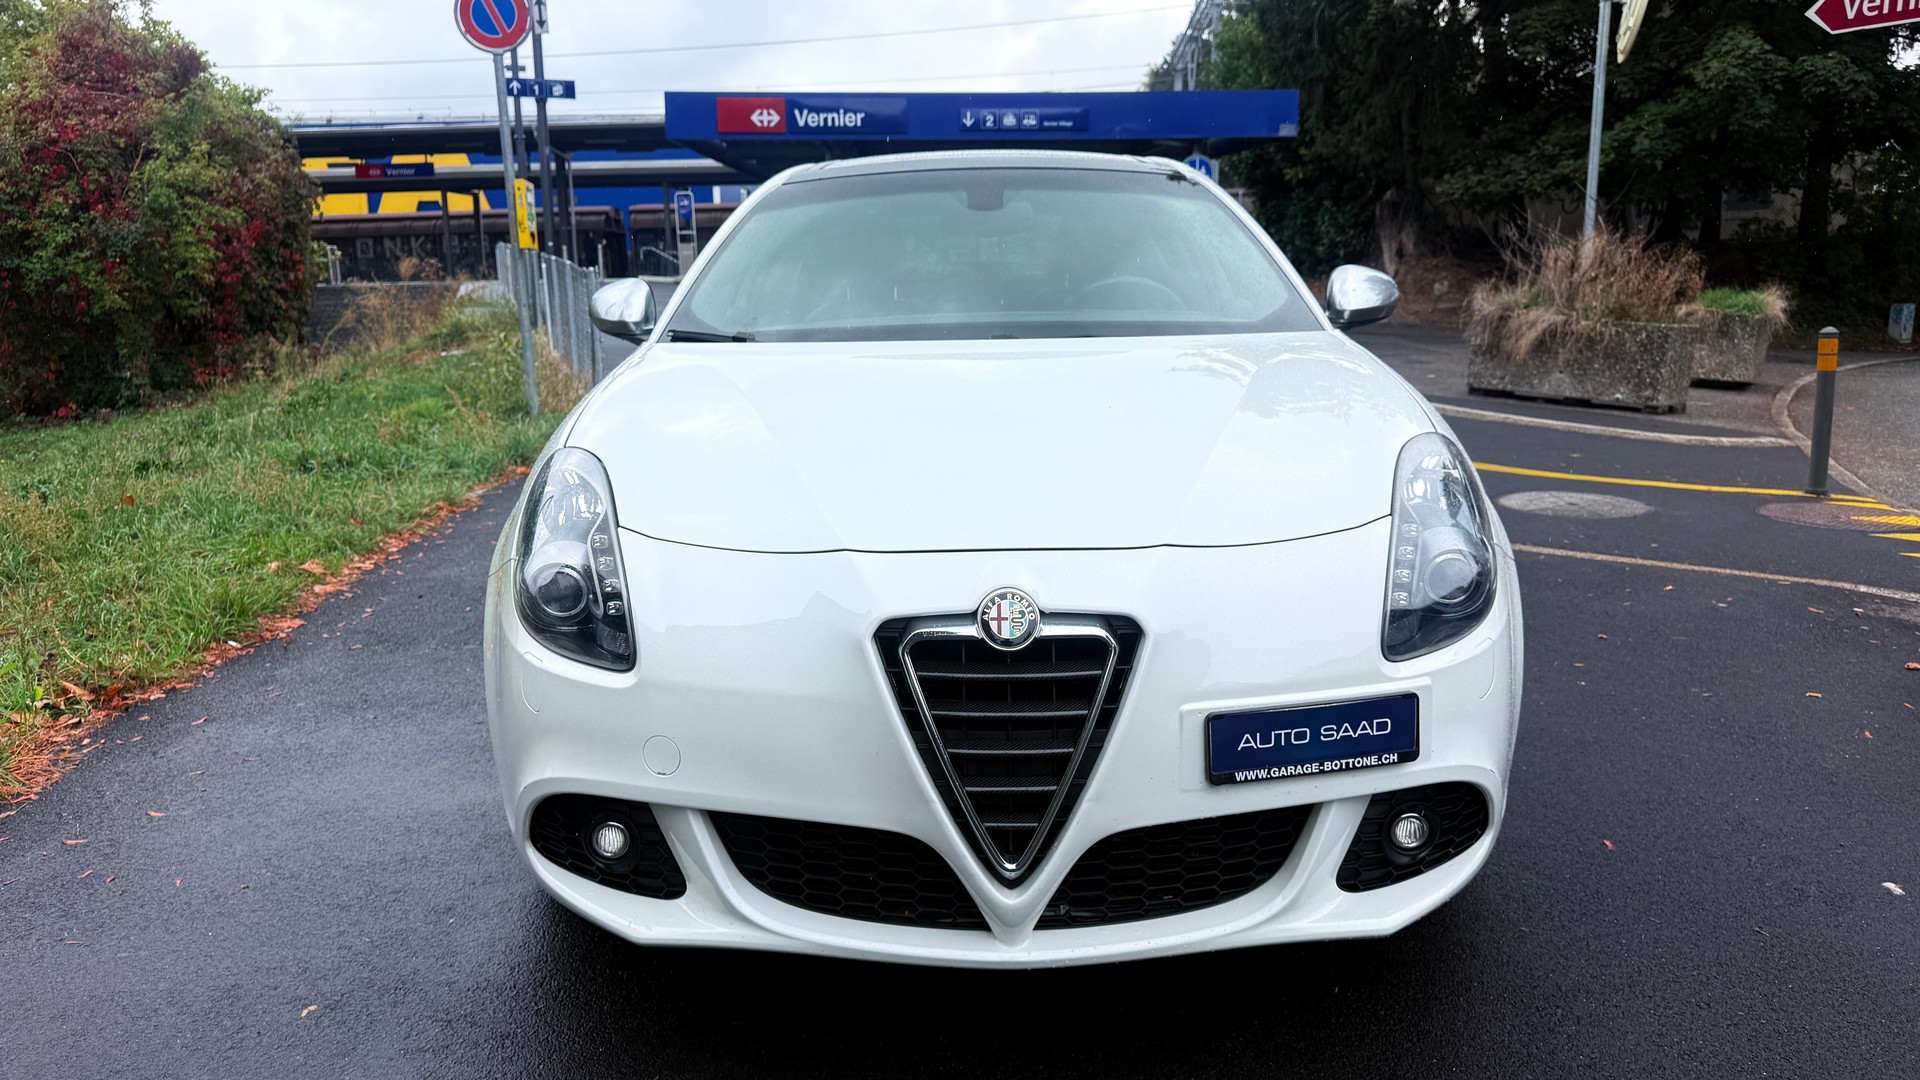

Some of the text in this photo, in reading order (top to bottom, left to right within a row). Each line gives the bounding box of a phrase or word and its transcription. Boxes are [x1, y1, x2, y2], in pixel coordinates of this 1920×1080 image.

[793, 108, 866, 127] Vernier
[985, 115, 994, 127] 2
[385, 166, 416, 177] Vernier
[982, 593, 1036, 621] ALFA ROMEO
[1237, 718, 1392, 751] AUTO SAAD
[1234, 752, 1398, 782] WWW.GARAGE-BOTTONE.CH
